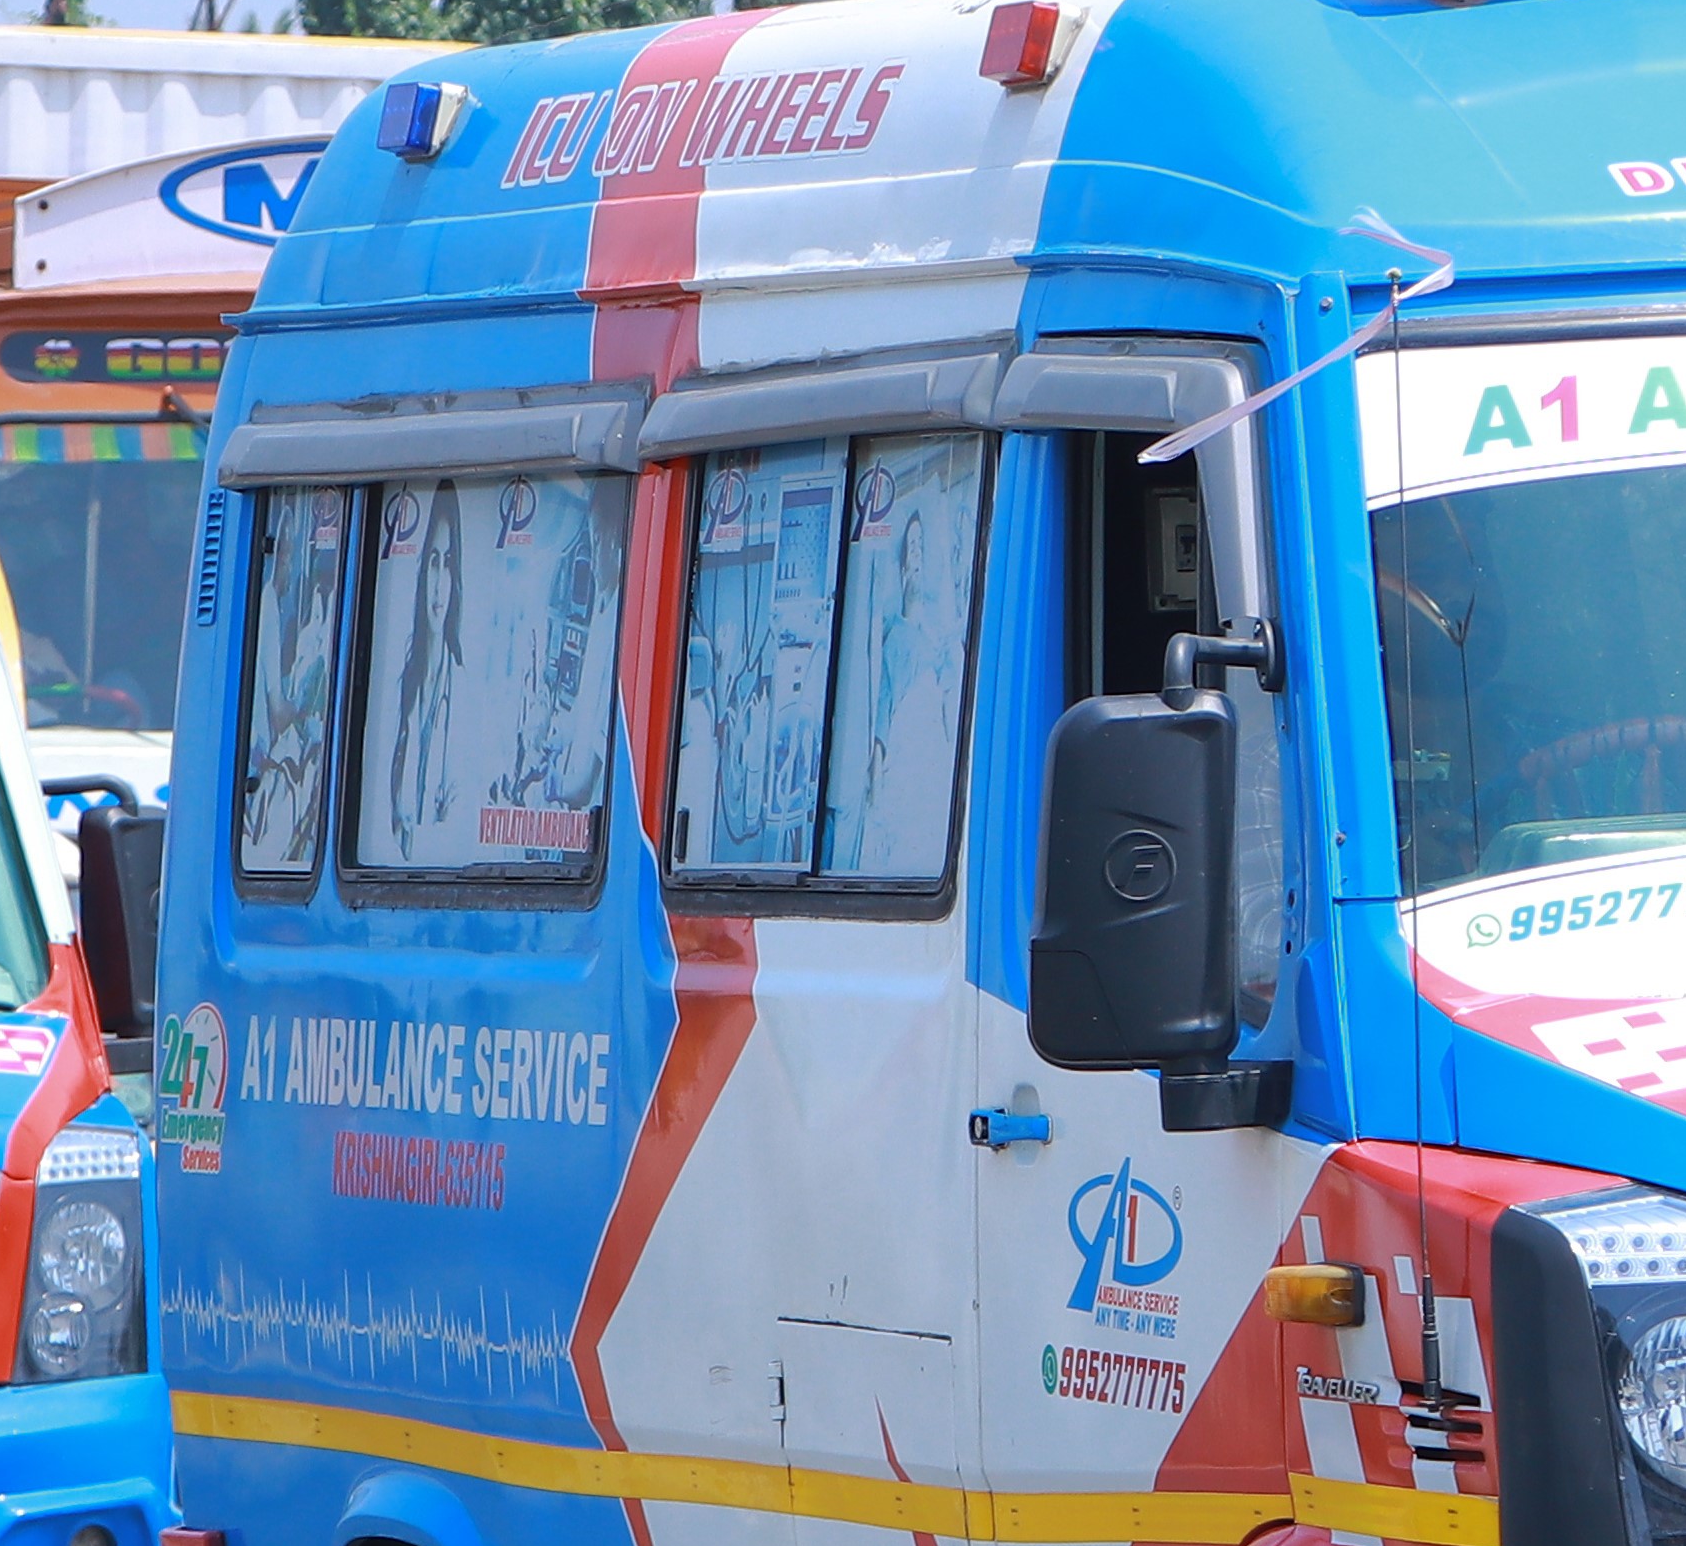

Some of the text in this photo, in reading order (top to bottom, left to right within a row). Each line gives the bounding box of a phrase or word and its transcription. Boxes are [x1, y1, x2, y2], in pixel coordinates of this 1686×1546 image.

[501, 59, 905, 189] ICU ON WHEELS
[1621, 162, 1669, 196] D
[1462, 375, 1582, 456] A1
[240, 1015, 611, 1127] A1 AMBULANCE SERVICE
[161, 1107, 226, 1145] Emergency
[182, 1145, 221, 1173] Services
[1097, 1285, 1180, 1317] AMBULANCE SERVICE
[1095, 1306, 1112, 1327] ANY
[1113, 1309, 1131, 1333] TIME
[1135, 1314, 1153, 1337] ANY
[1153, 1317, 1177, 1340] WERE
[1059, 1346, 1187, 1415] 9952777775
